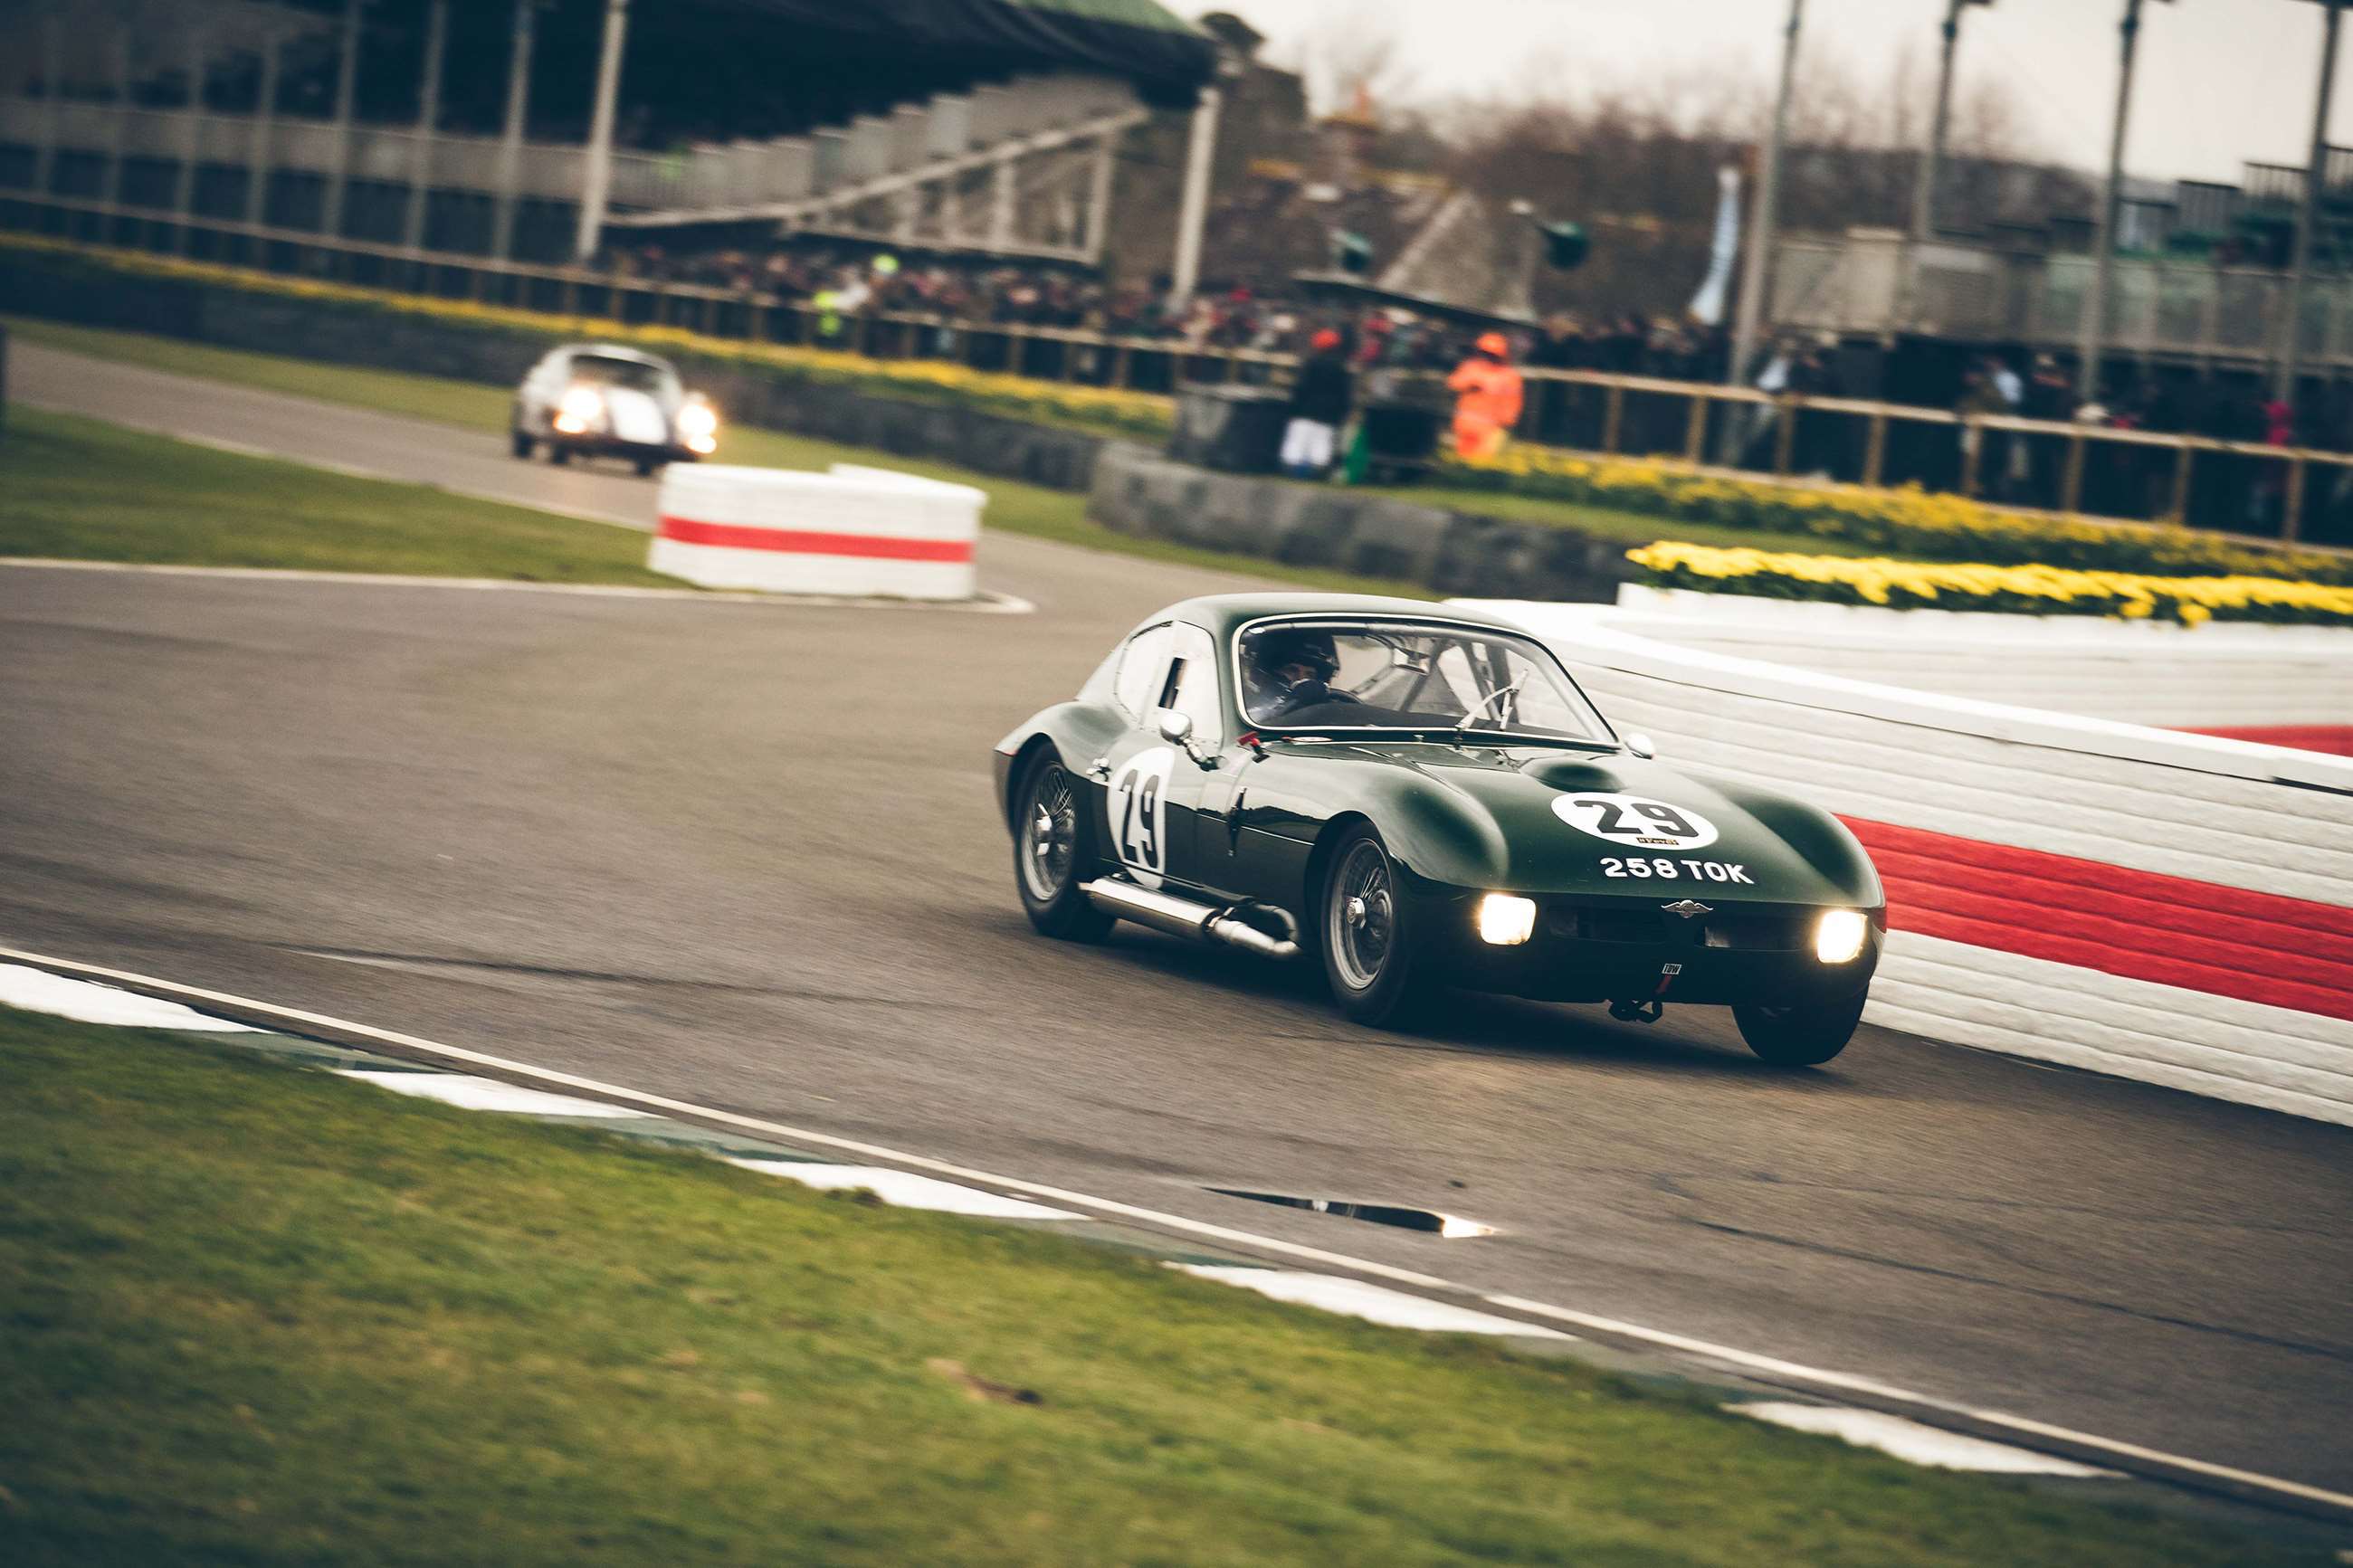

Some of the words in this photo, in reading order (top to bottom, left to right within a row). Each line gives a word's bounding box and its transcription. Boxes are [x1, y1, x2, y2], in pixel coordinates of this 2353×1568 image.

[1120, 769, 1159, 869] 29
[1573, 800, 1699, 837] 29
[1600, 858, 1678, 879] 258
[1681, 860, 1755, 885] TOK
